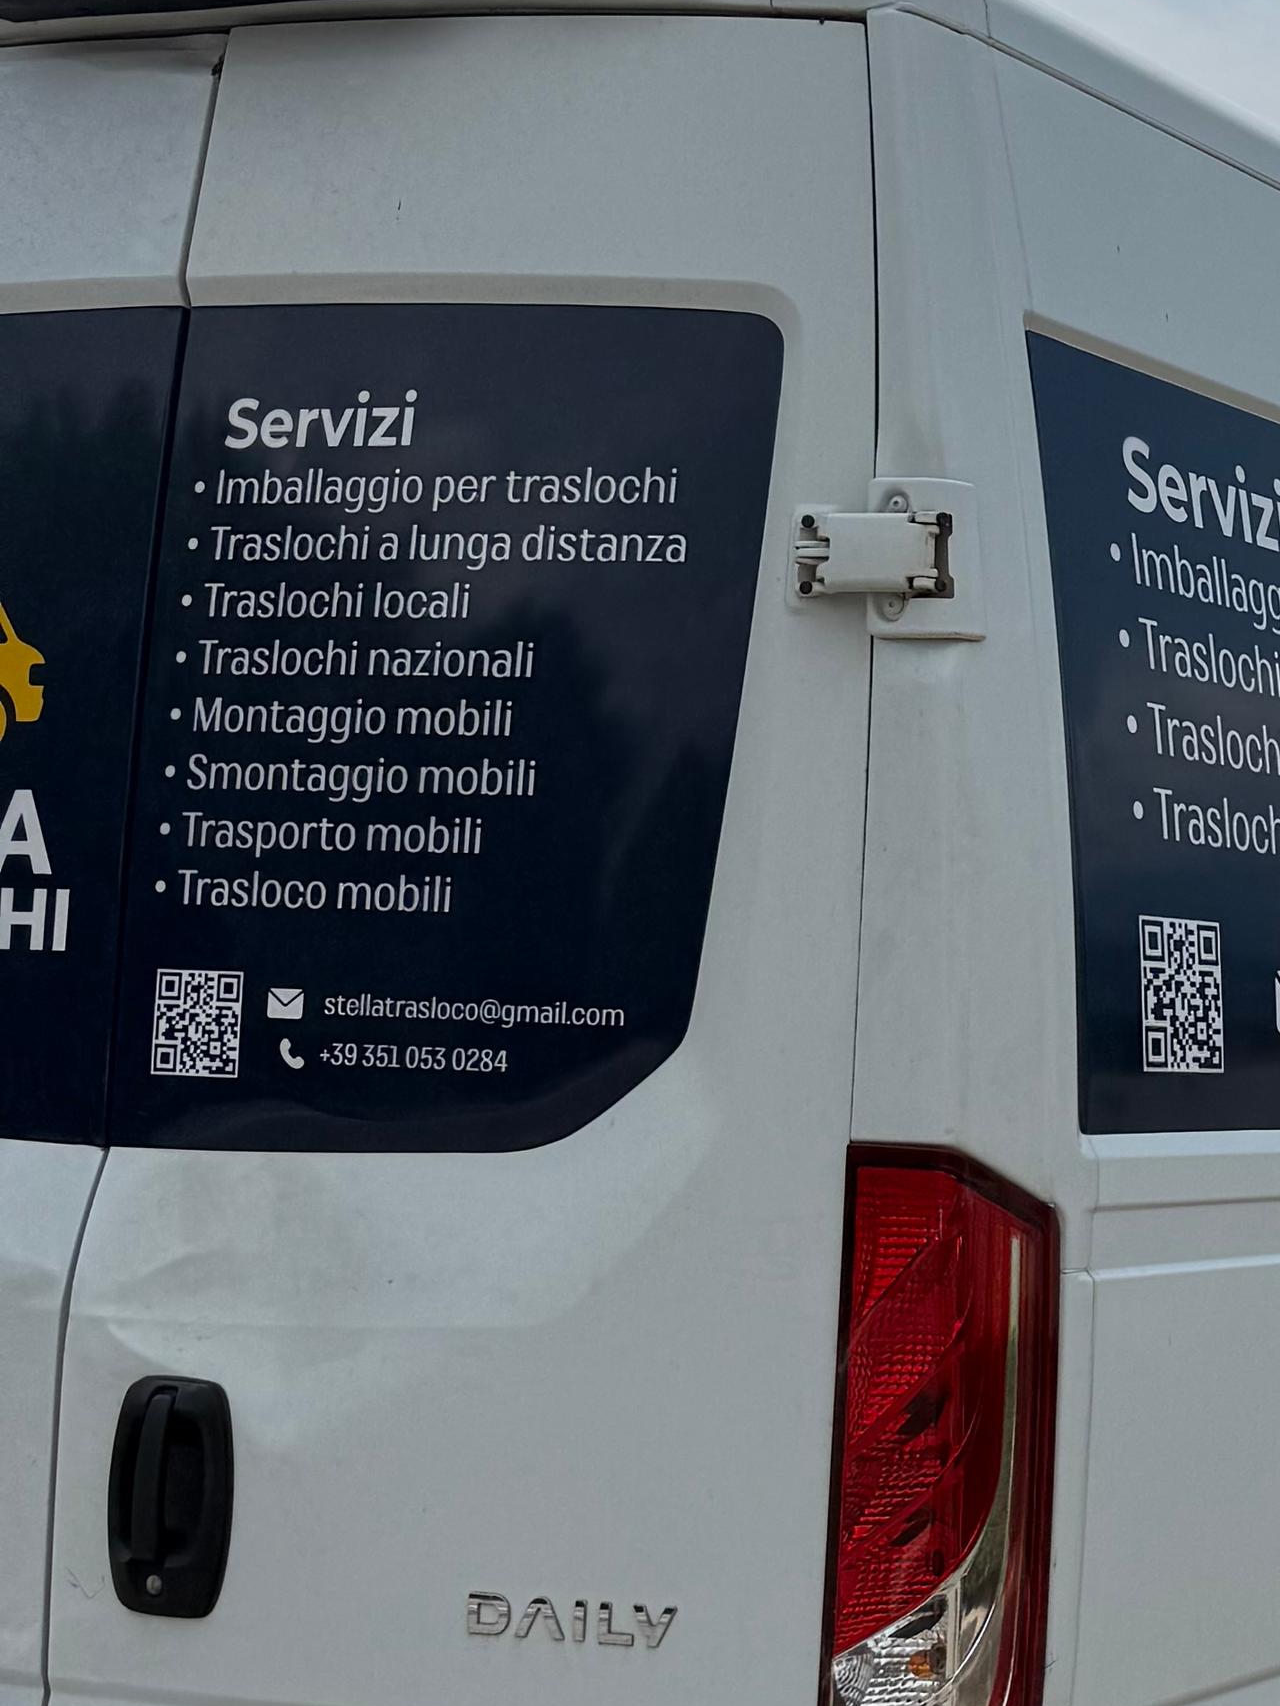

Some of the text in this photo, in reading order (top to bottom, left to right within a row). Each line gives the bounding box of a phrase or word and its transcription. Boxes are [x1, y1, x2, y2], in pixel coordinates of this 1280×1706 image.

[224, 389, 418, 449] Servizi
[216, 466, 678, 514] Imballaggio per traslochi
[210, 524, 687, 571] Traslochi a lunga distanza
[204, 581, 471, 619] Traslochi locali
[198, 639, 534, 678] Traslochi nazionali
[192, 696, 513, 744] Montaggio mobili
[186, 753, 536, 803] Smontaggio mobili
[182, 811, 482, 858] Trasporto mobili
[177, 869, 452, 913] Trasloco mobili
[324, 993, 625, 1029] stellatrasloco@gmail.com
[319, 1042, 508, 1073] +39 351 053 0284
[467, 1591, 678, 1648] DAILY
